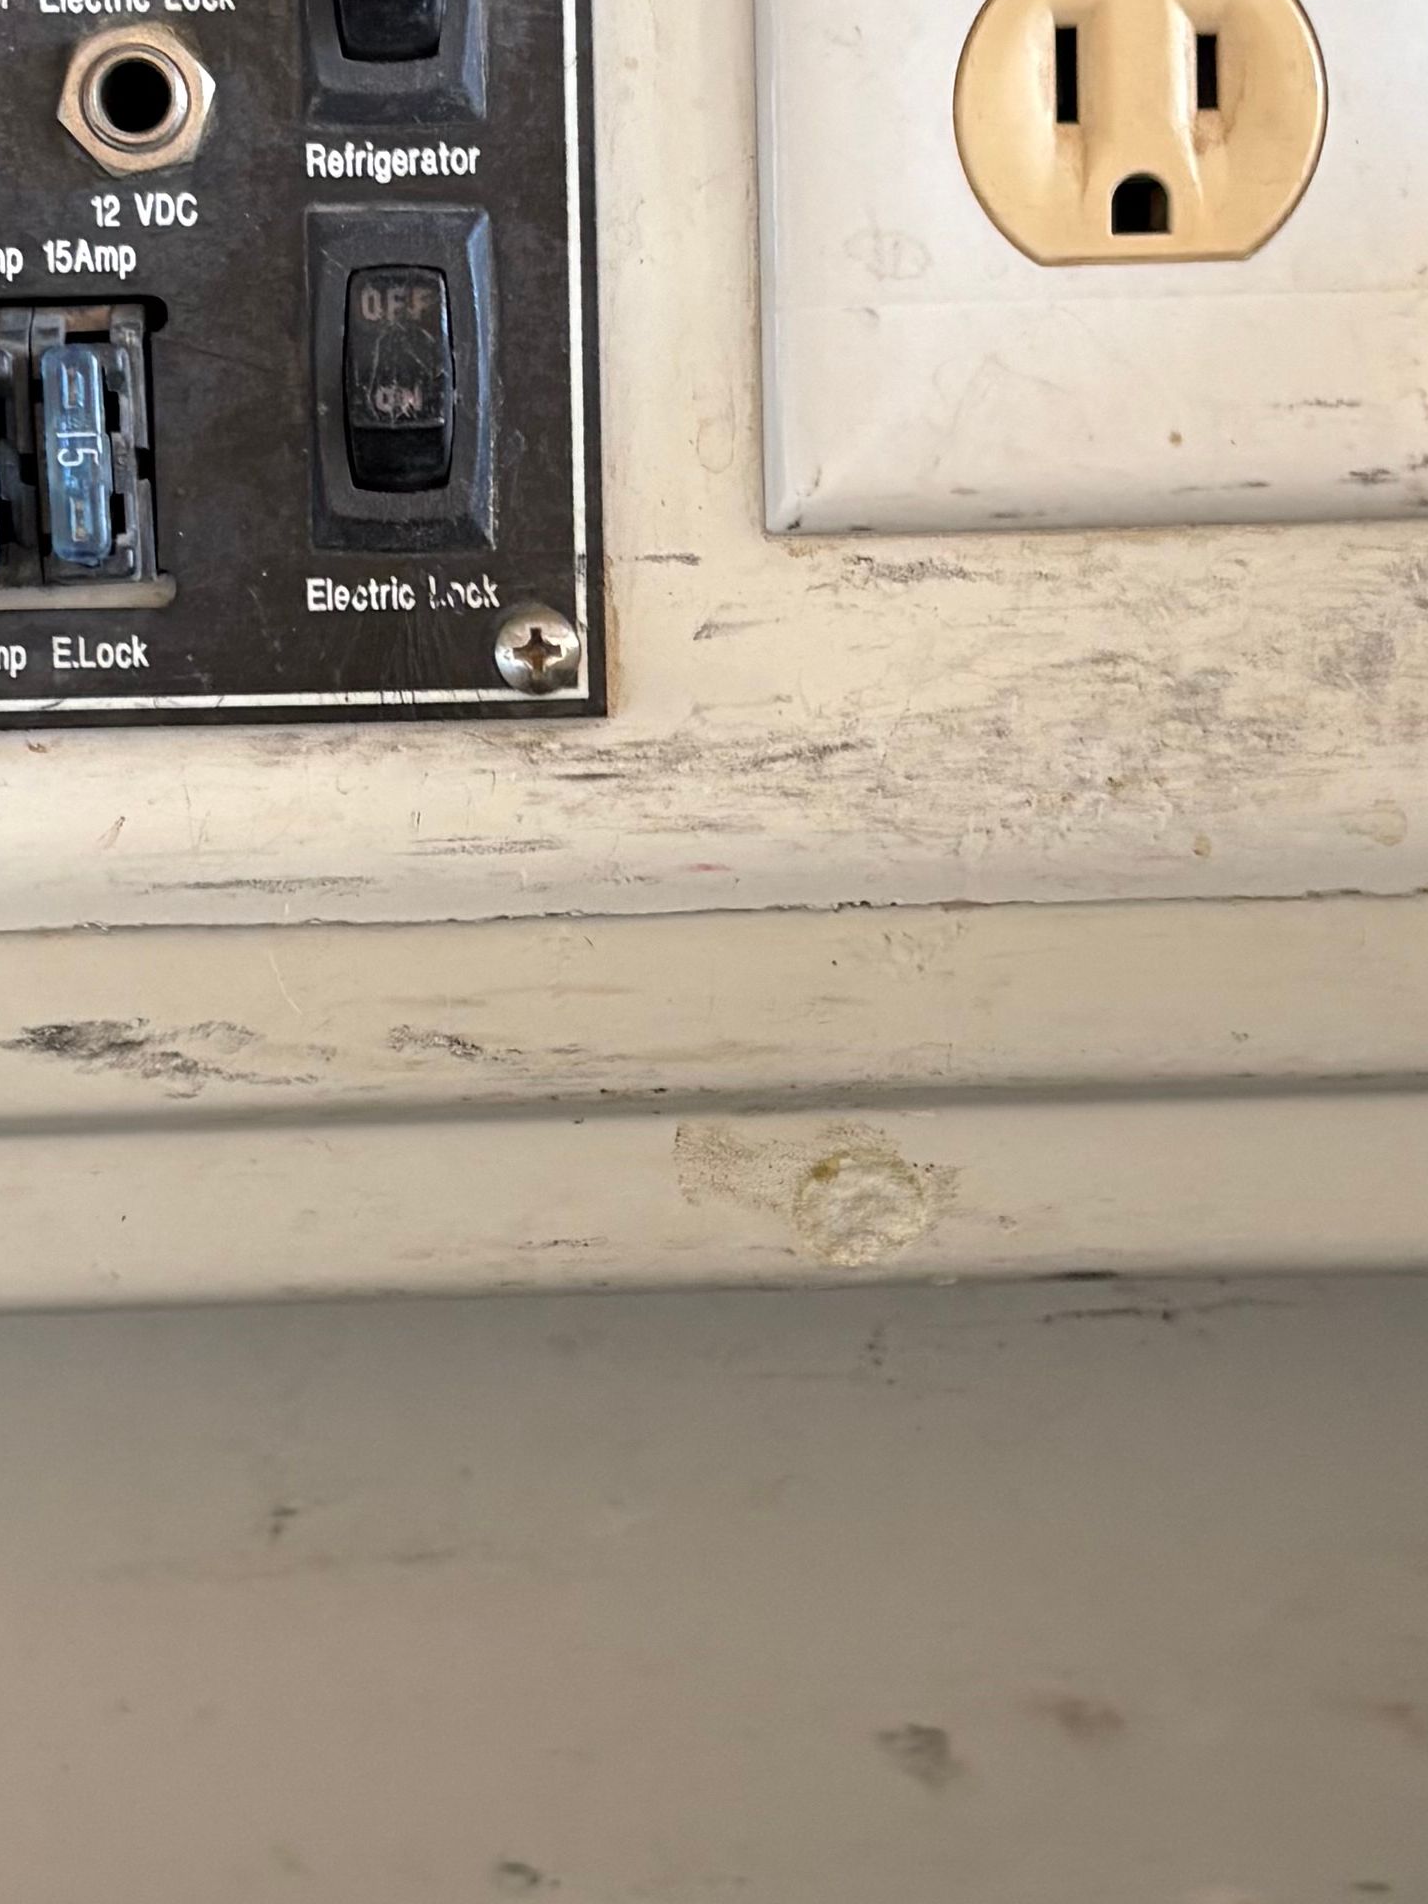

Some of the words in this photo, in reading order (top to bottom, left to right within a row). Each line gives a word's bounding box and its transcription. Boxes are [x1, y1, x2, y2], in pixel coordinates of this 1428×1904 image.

[305, 141, 481, 184] Refrigerator
[90, 194, 121, 228] 12
[133, 191, 199, 227] VDC
[42, 238, 137, 280] 15Amp
[361, 288, 430, 322] OFF
[375, 386, 421, 414] ON
[56, 432, 100, 468] 15
[306, 575, 416, 612] Electric
[52, 634, 150, 669] E.Lock
